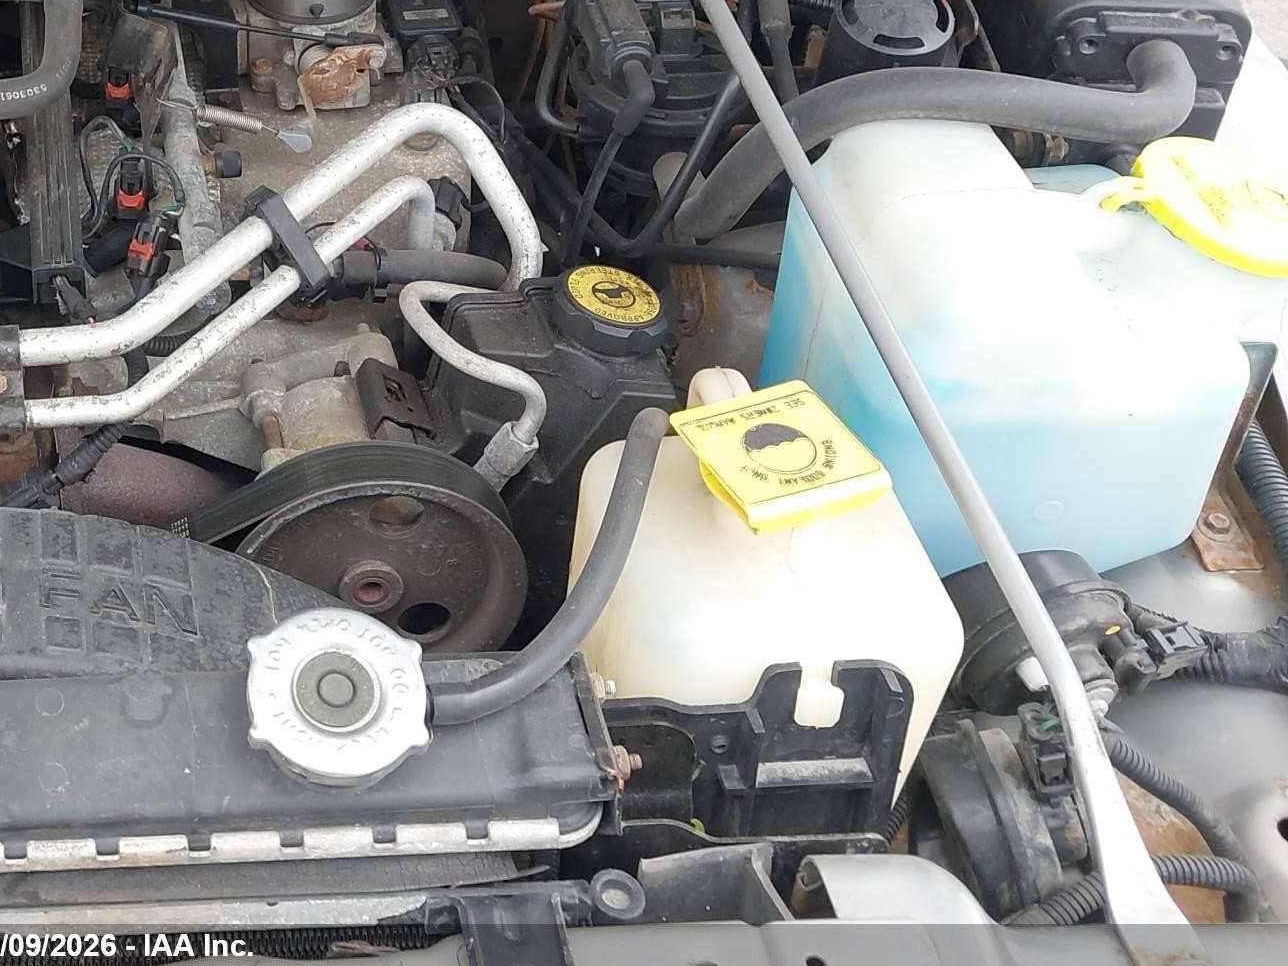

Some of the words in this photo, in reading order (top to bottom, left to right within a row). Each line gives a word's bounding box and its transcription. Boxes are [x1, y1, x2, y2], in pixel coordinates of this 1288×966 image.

[594, 307, 644, 322] APPROVED
[783, 397, 806, 410] SEE
[39, 565, 201, 638] FAN
